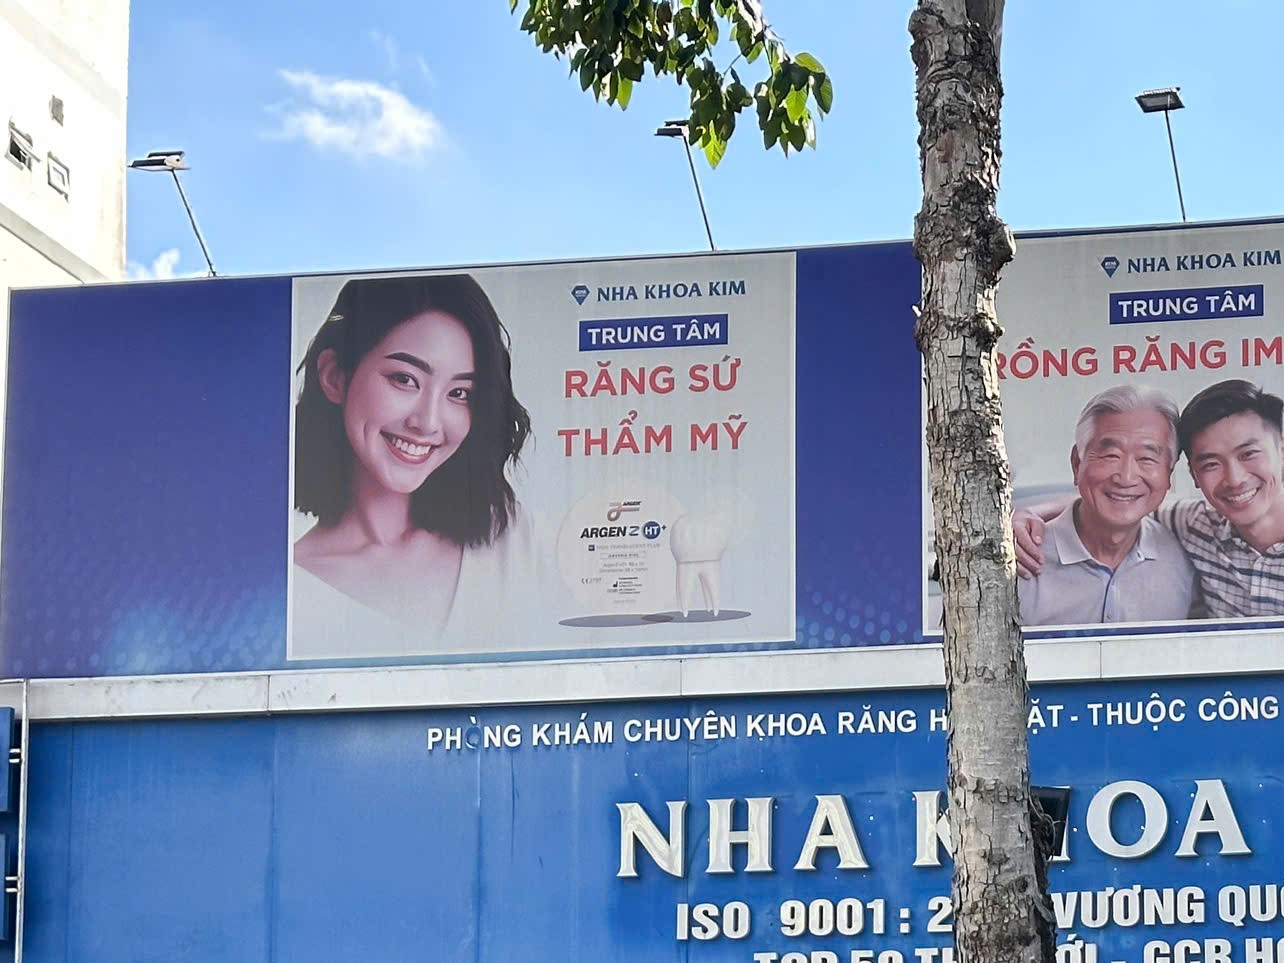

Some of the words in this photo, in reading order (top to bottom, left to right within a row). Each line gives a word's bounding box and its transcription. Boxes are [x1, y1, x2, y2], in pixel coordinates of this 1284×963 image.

[1127, 257, 1170, 274] NHA
[1176, 253, 1236, 271] KHOA
[1243, 249, 1282, 267] KIM
[597, 285, 638, 302] NHA
[645, 282, 702, 299] KHOA
[708, 280, 746, 297] KIM
[1118, 297, 1198, 318] TRUNG
[1206, 291, 1256, 313] TÂM
[588, 325, 665, 345] TRUNG
[672, 319, 720, 341] TÂM
[565, 361, 675, 398] RĂNG
[688, 355, 741, 392] SỨ
[998, 337, 1098, 380] ỒNG
[1113, 335, 1226, 374] RĂNG
[558, 409, 673, 457] THẨM
[690, 414, 748, 452] MỸ
[532, 713, 613, 746] KHÁM
[624, 710, 736, 743] CHUYÊN
[747, 712, 826, 741] KHOA
[838, 705, 917, 735] RĂNG
[1027, 699, 1064, 734] ẶT
[1087, 693, 1187, 731] THUỘC
[1198, 691, 1279, 721] CÔNG
[616, 794, 869, 878] NHA
[912, 778, 1252, 867] KOA
[677, 901, 751, 940] ISO
[1052, 884, 1204, 929] VƯƠNG
